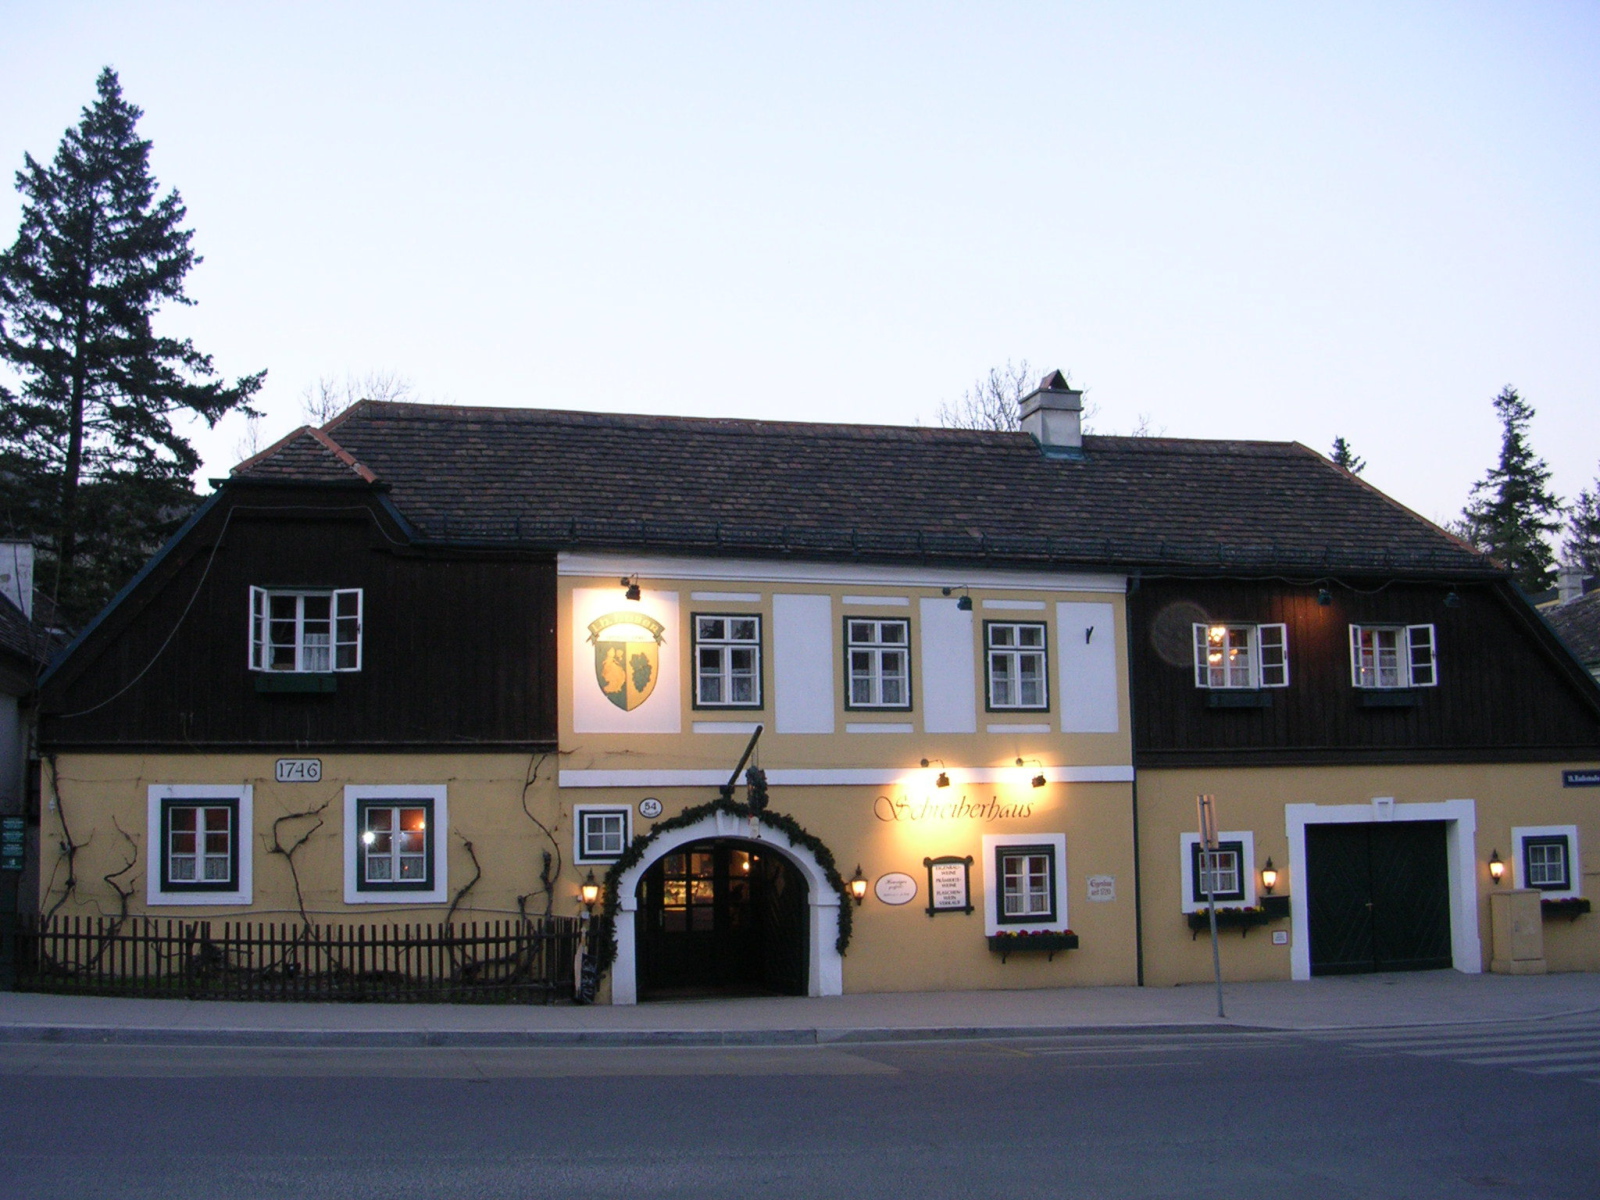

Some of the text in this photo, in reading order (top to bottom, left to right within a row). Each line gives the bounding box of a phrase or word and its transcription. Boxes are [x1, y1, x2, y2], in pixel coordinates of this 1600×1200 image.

[280, 762, 318, 778] 1746
[644, 801, 657, 810] 54
[873, 794, 1034, 823] Schreiberhaus
